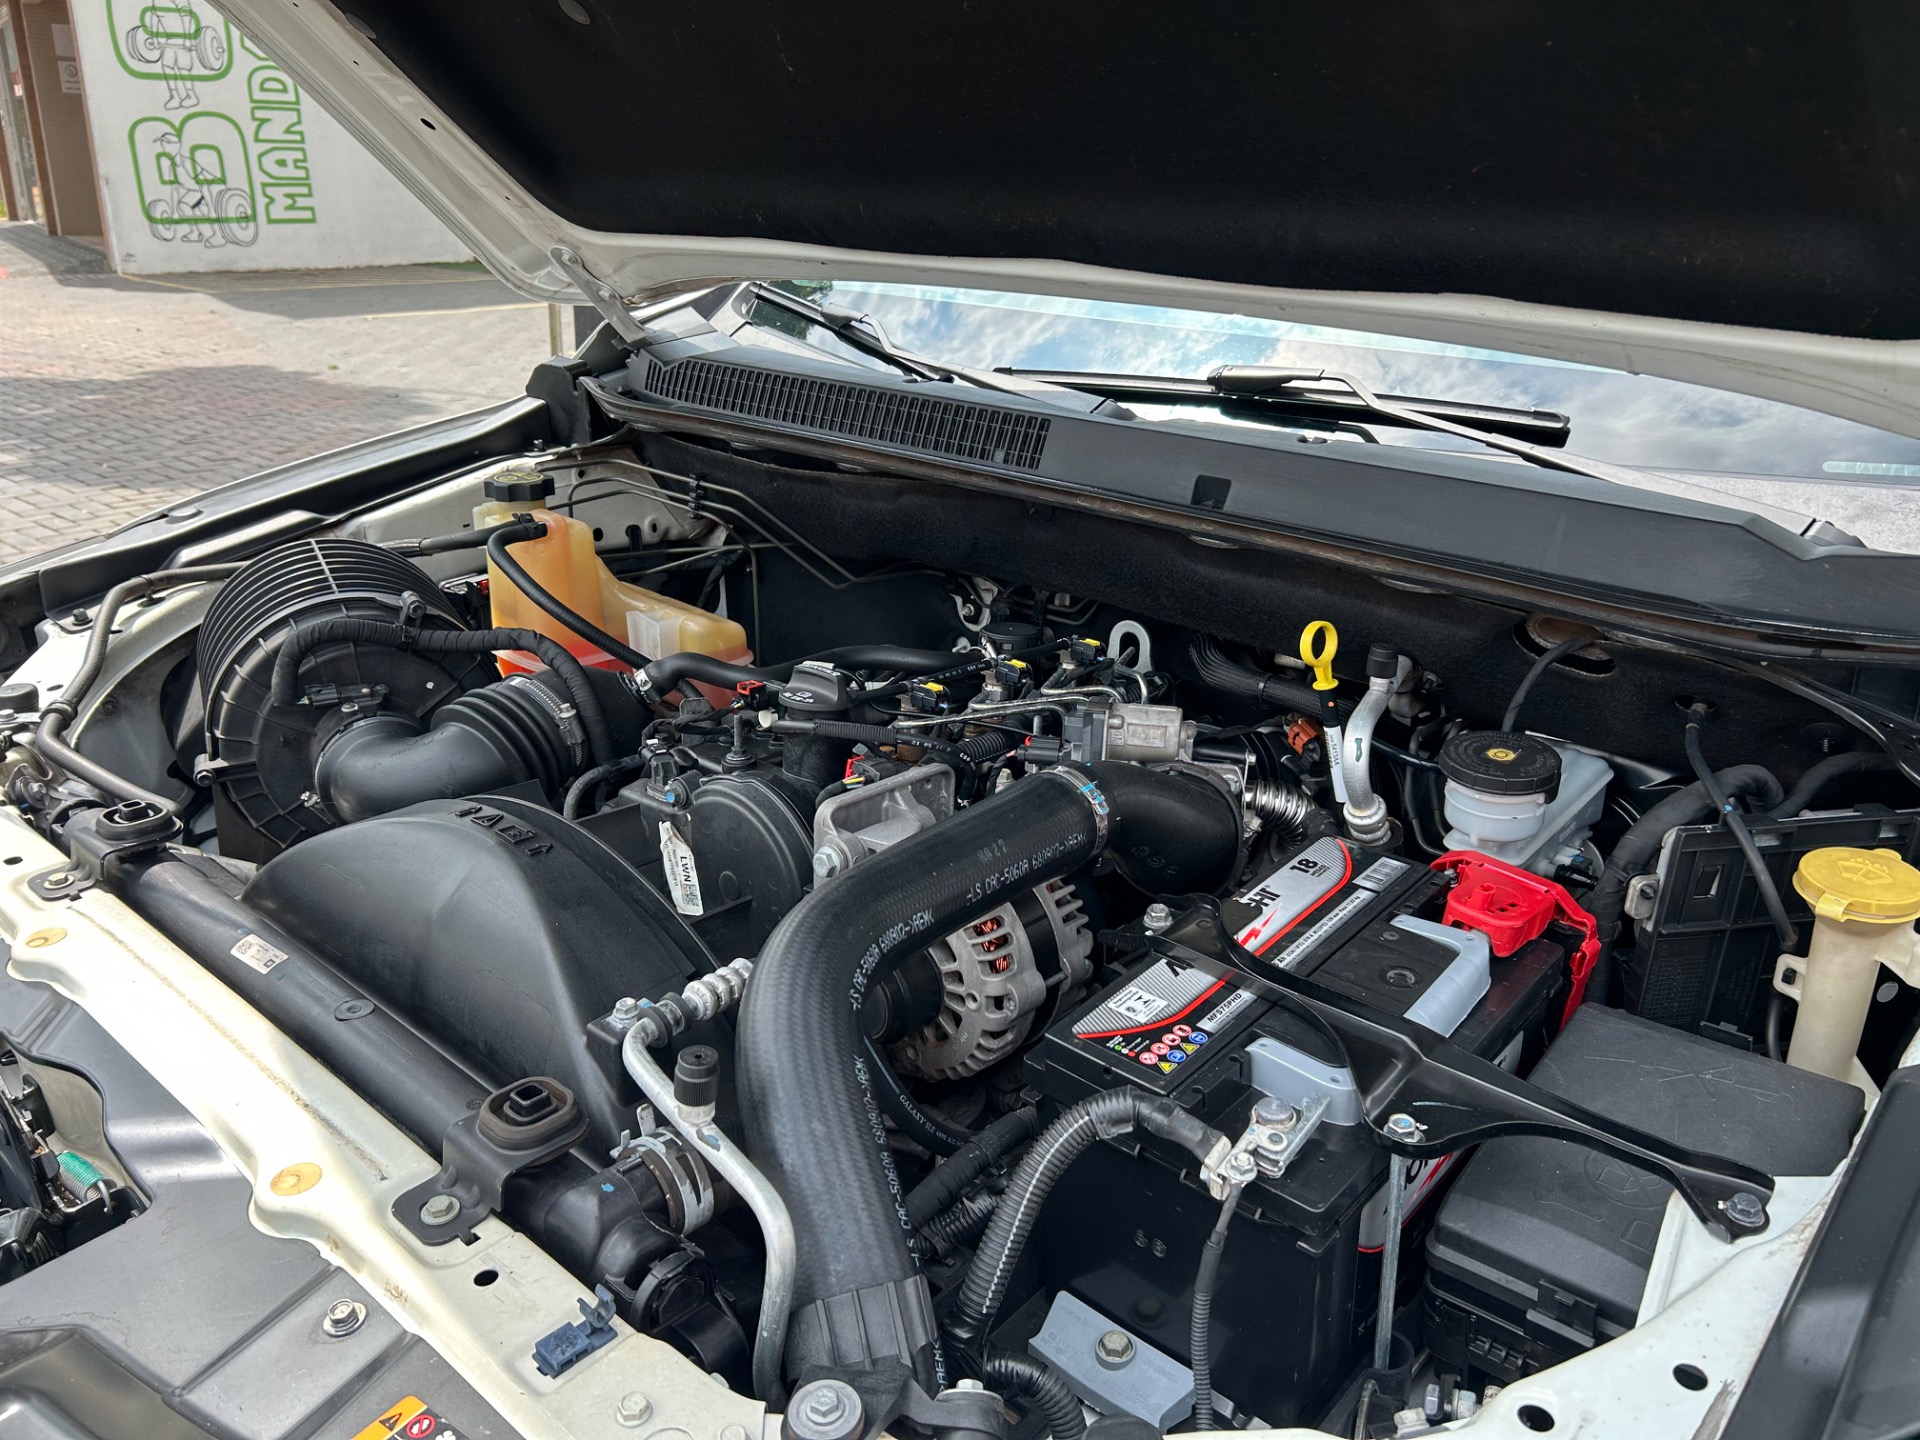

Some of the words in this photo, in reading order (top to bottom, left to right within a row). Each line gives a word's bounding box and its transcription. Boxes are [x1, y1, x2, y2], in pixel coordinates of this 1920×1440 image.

[680, 855, 692, 883] LWN
[1289, 858, 1319, 874] 18
[1207, 993, 1242, 1023] MFS75PHD
[900, 1095, 927, 1124] GALAXY
